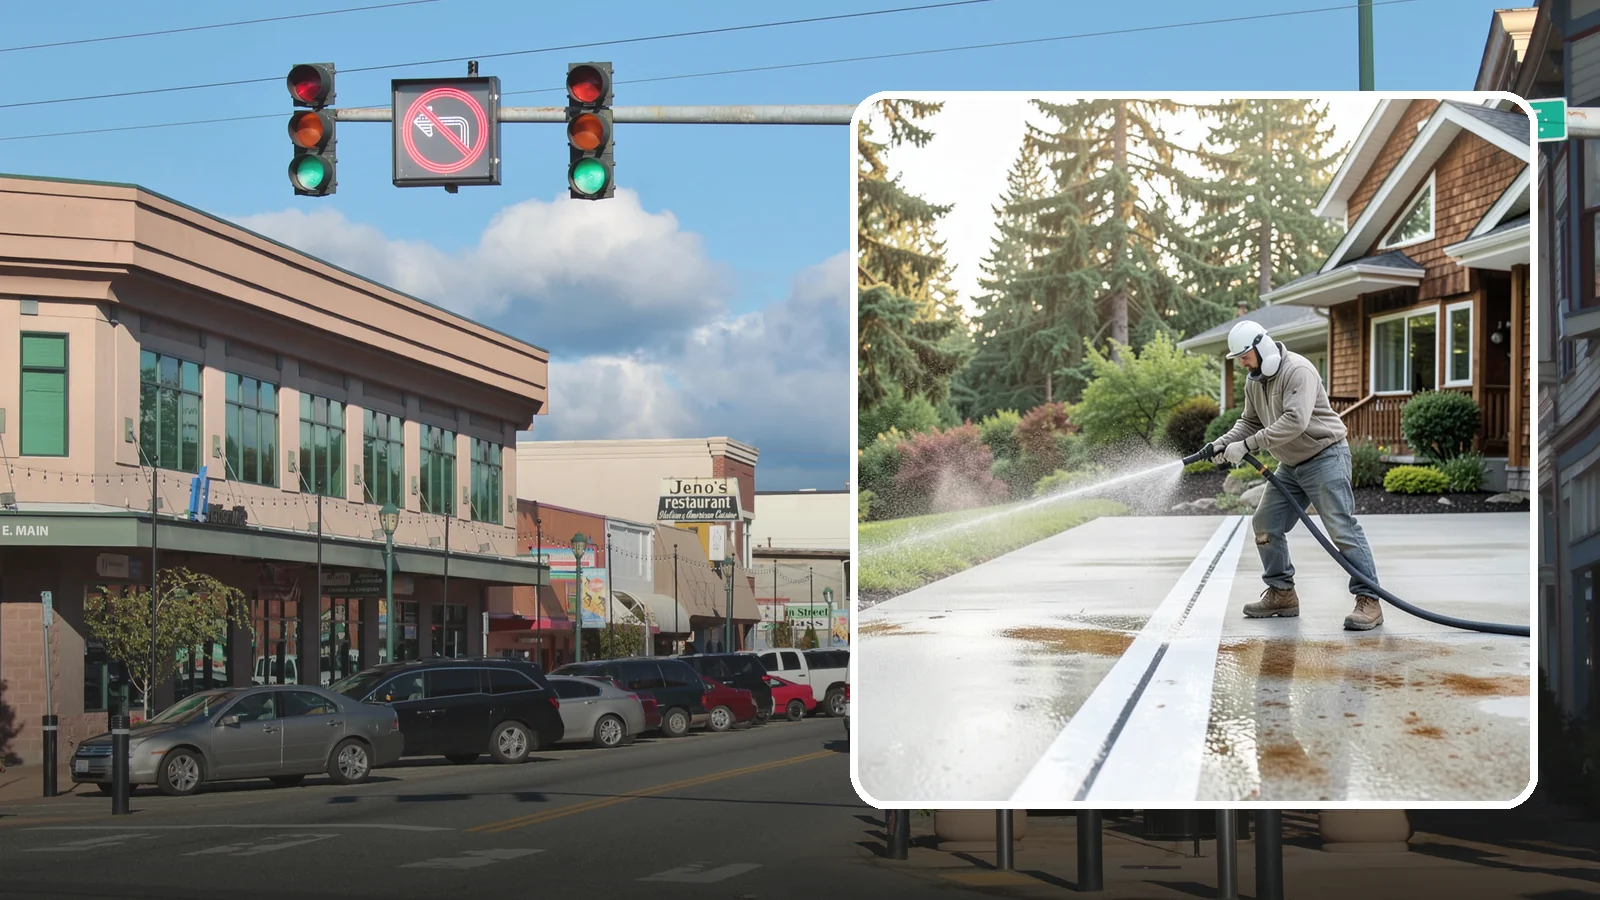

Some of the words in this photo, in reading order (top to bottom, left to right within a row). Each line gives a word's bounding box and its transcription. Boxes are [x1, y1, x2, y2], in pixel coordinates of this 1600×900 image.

[670, 480, 727, 494] Jeno's
[665, 497, 731, 509] restaurant
[659, 509, 681, 519] Italian
[686, 509, 715, 519] American
[715, 509, 738, 519] Cuisine
[2, 525, 13, 536] E.
[15, 525, 49, 536] MAIN
[797, 607, 829, 617] Street
